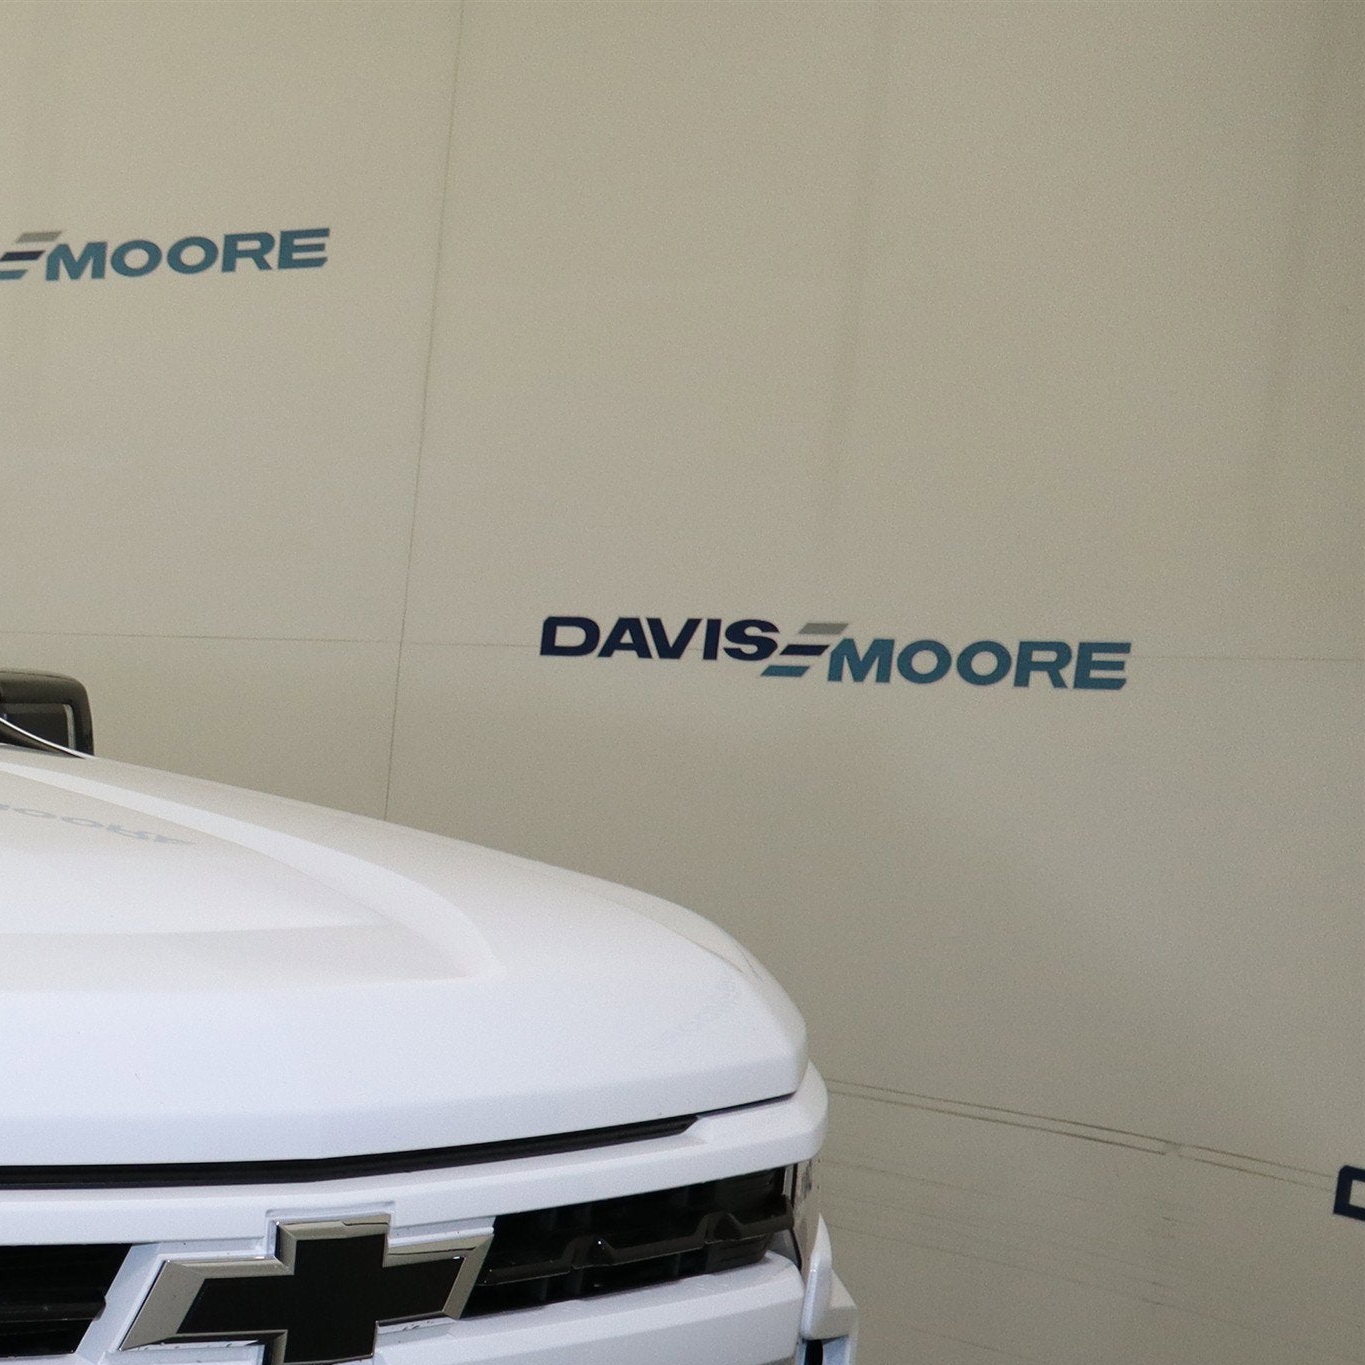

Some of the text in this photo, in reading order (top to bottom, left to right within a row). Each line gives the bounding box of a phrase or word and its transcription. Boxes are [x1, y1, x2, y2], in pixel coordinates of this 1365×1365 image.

[45, 228, 331, 281] MOORE
[539, 616, 1132, 691] DAVIS MOORE
